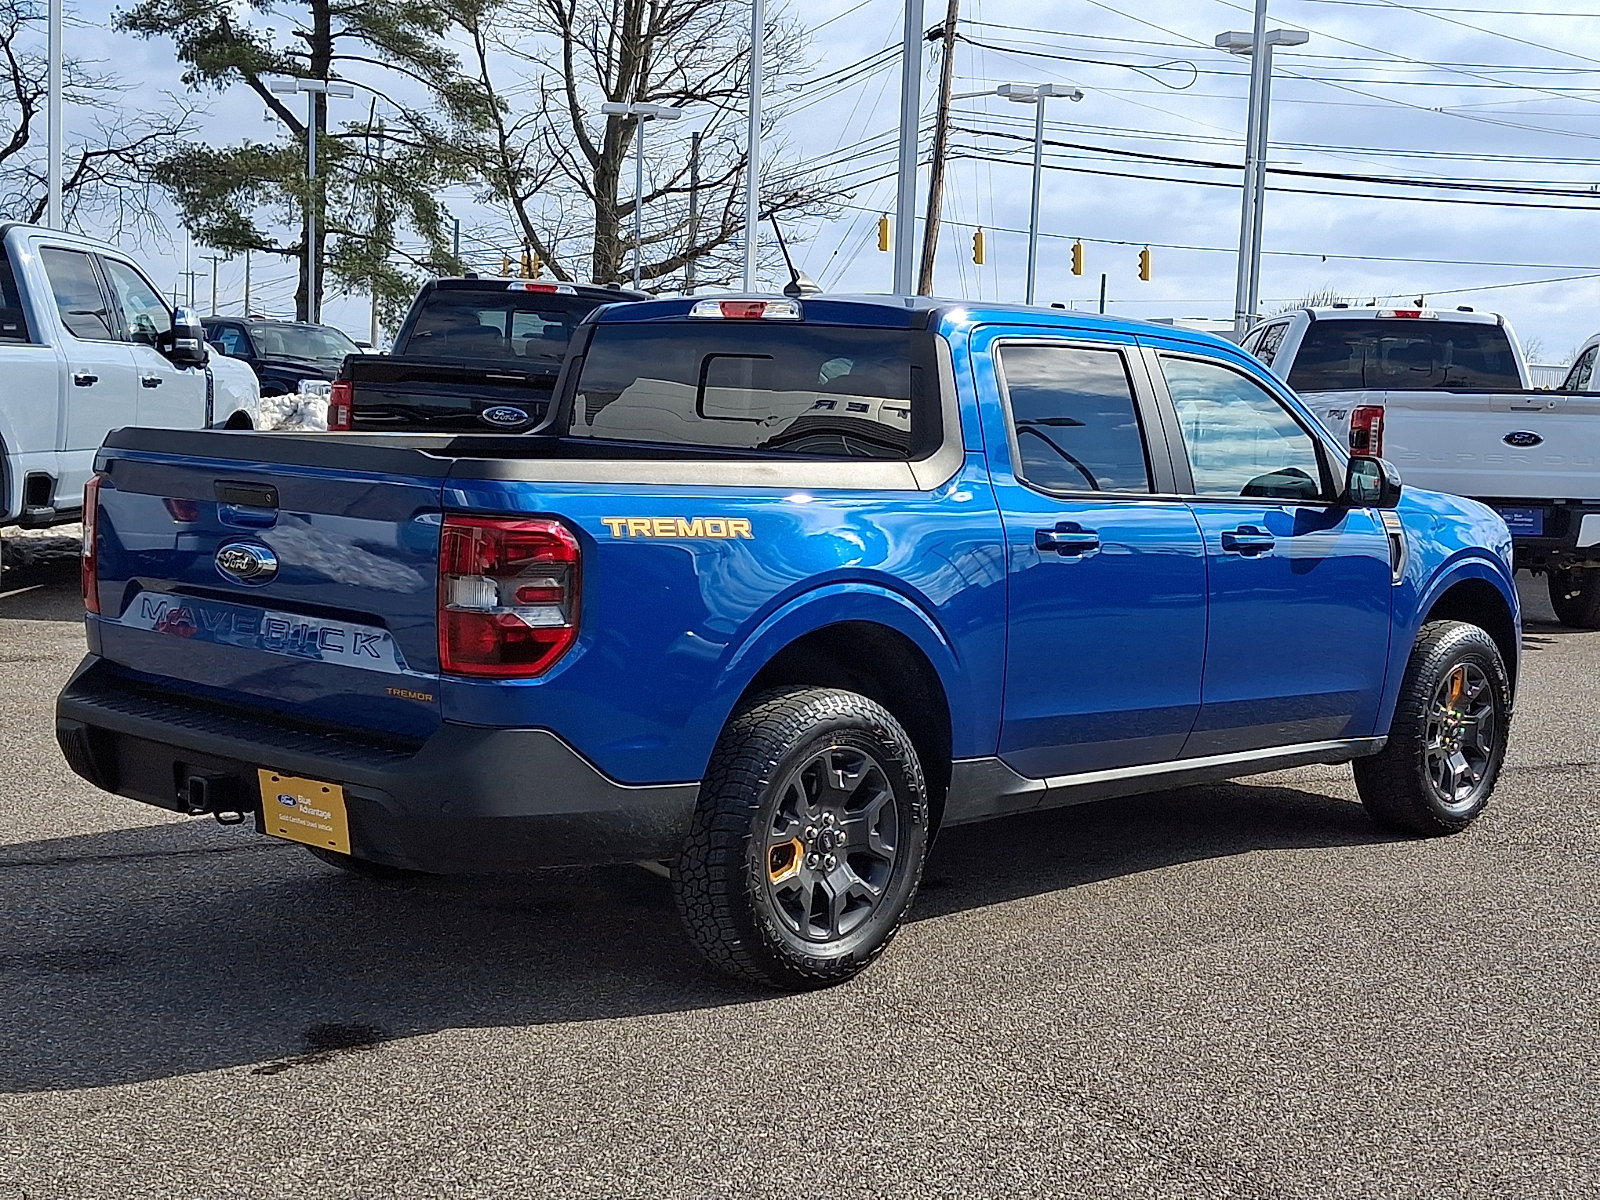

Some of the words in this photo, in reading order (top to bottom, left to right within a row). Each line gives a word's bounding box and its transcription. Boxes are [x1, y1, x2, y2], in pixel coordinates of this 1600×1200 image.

[493, 409, 518, 421] Ford
[601, 516, 755, 539] TREMOR
[222, 550, 251, 571] Ford
[141, 597, 382, 659] MAVERICK
[385, 687, 434, 702] TREMOR
[297, 795, 312, 805] Blue
[299, 804, 333, 820] Advantage
